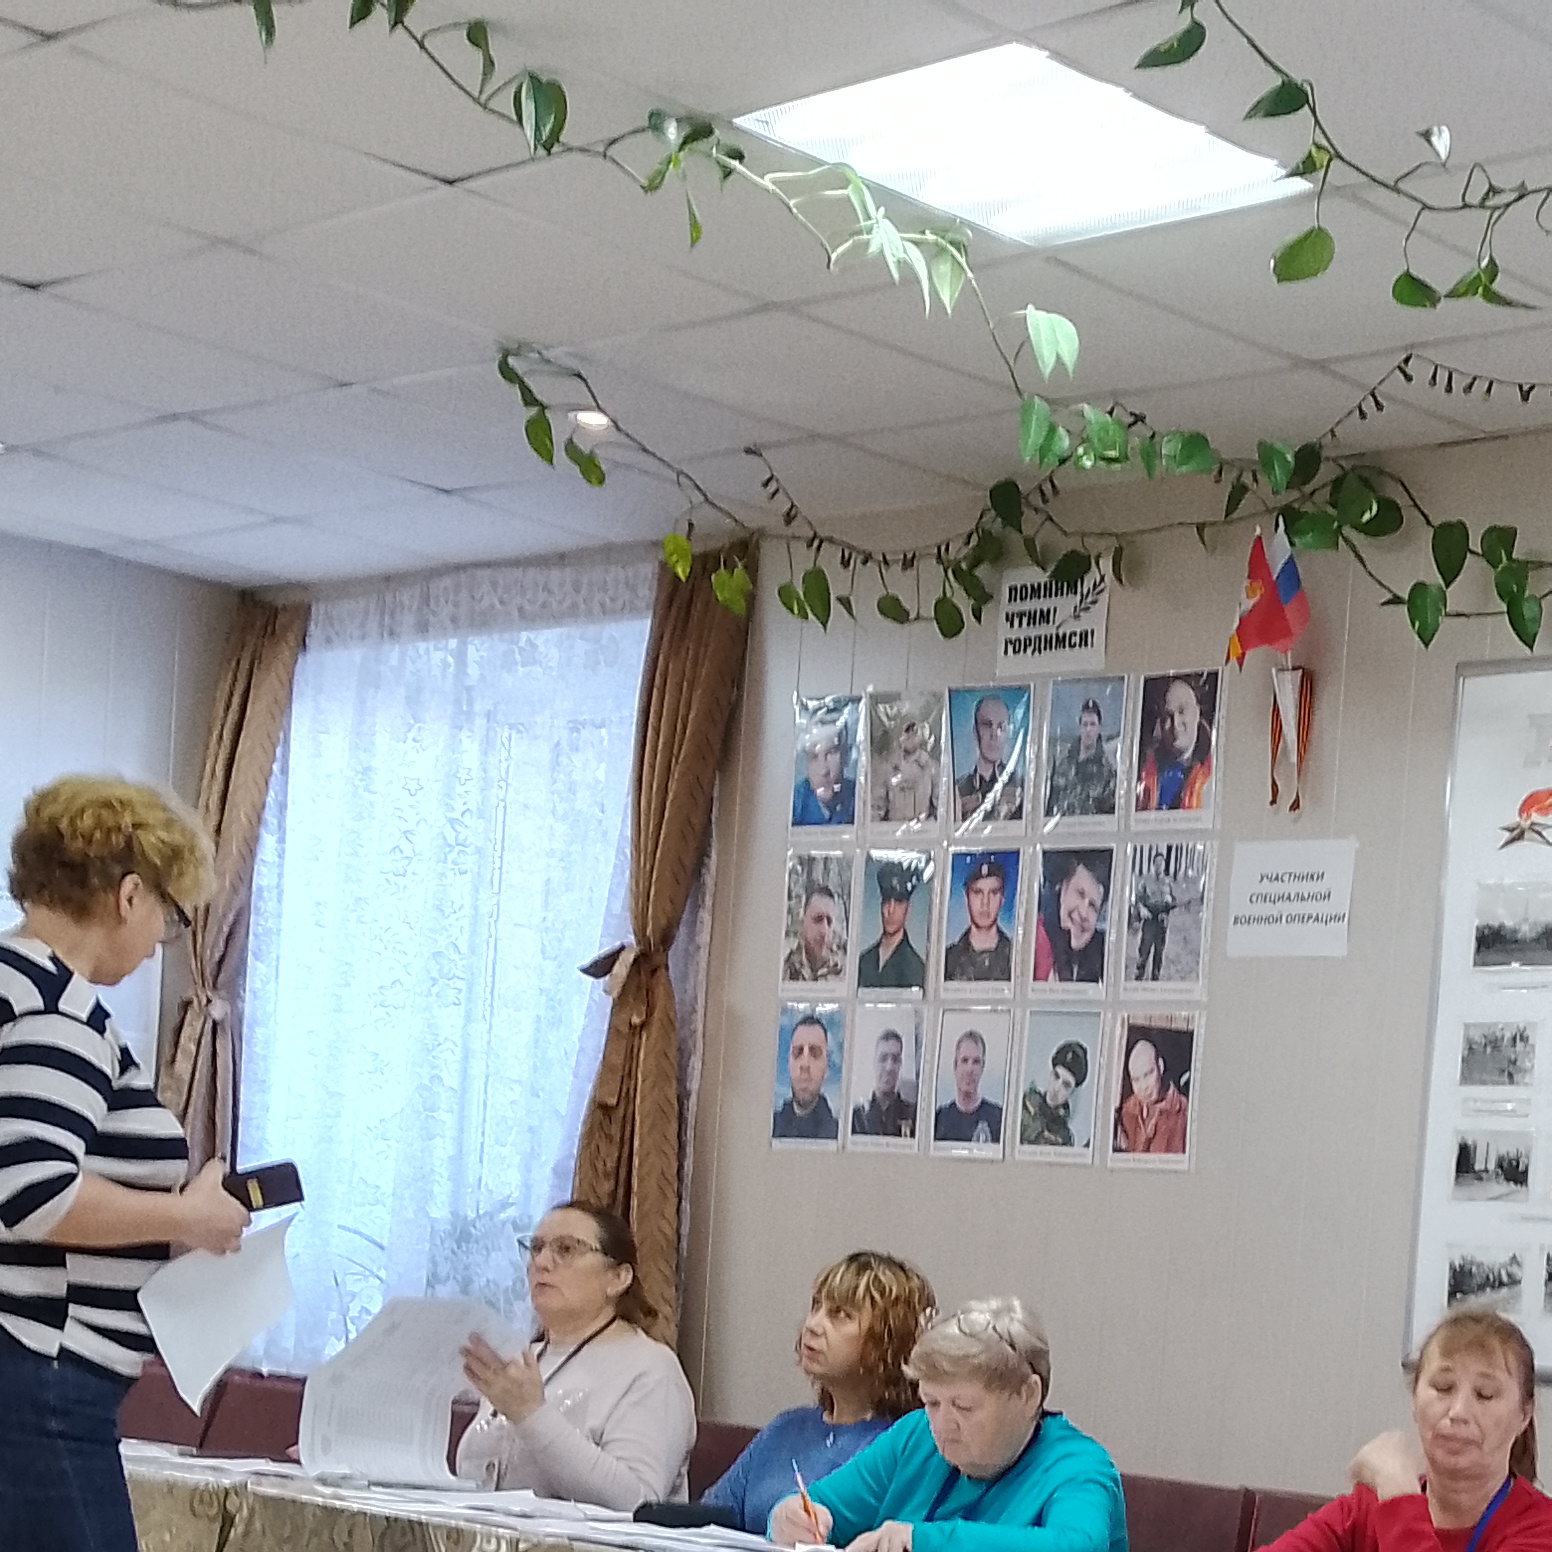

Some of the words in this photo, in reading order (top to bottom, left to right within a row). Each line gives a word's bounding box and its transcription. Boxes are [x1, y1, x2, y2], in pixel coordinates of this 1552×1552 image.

[1004, 606, 1058, 628] ЧТИМ!
[1003, 629, 1095, 656] ГОРДИМСЯ!
[1259, 871, 1325, 883] УЧАСТНИКИ
[1248, 888, 1331, 905] СПЕЦИАЛЬНОЙ
[1232, 911, 1283, 926] ВОЕННОЙ
[1285, 912, 1346, 926] ОПЕРАЦИИ
